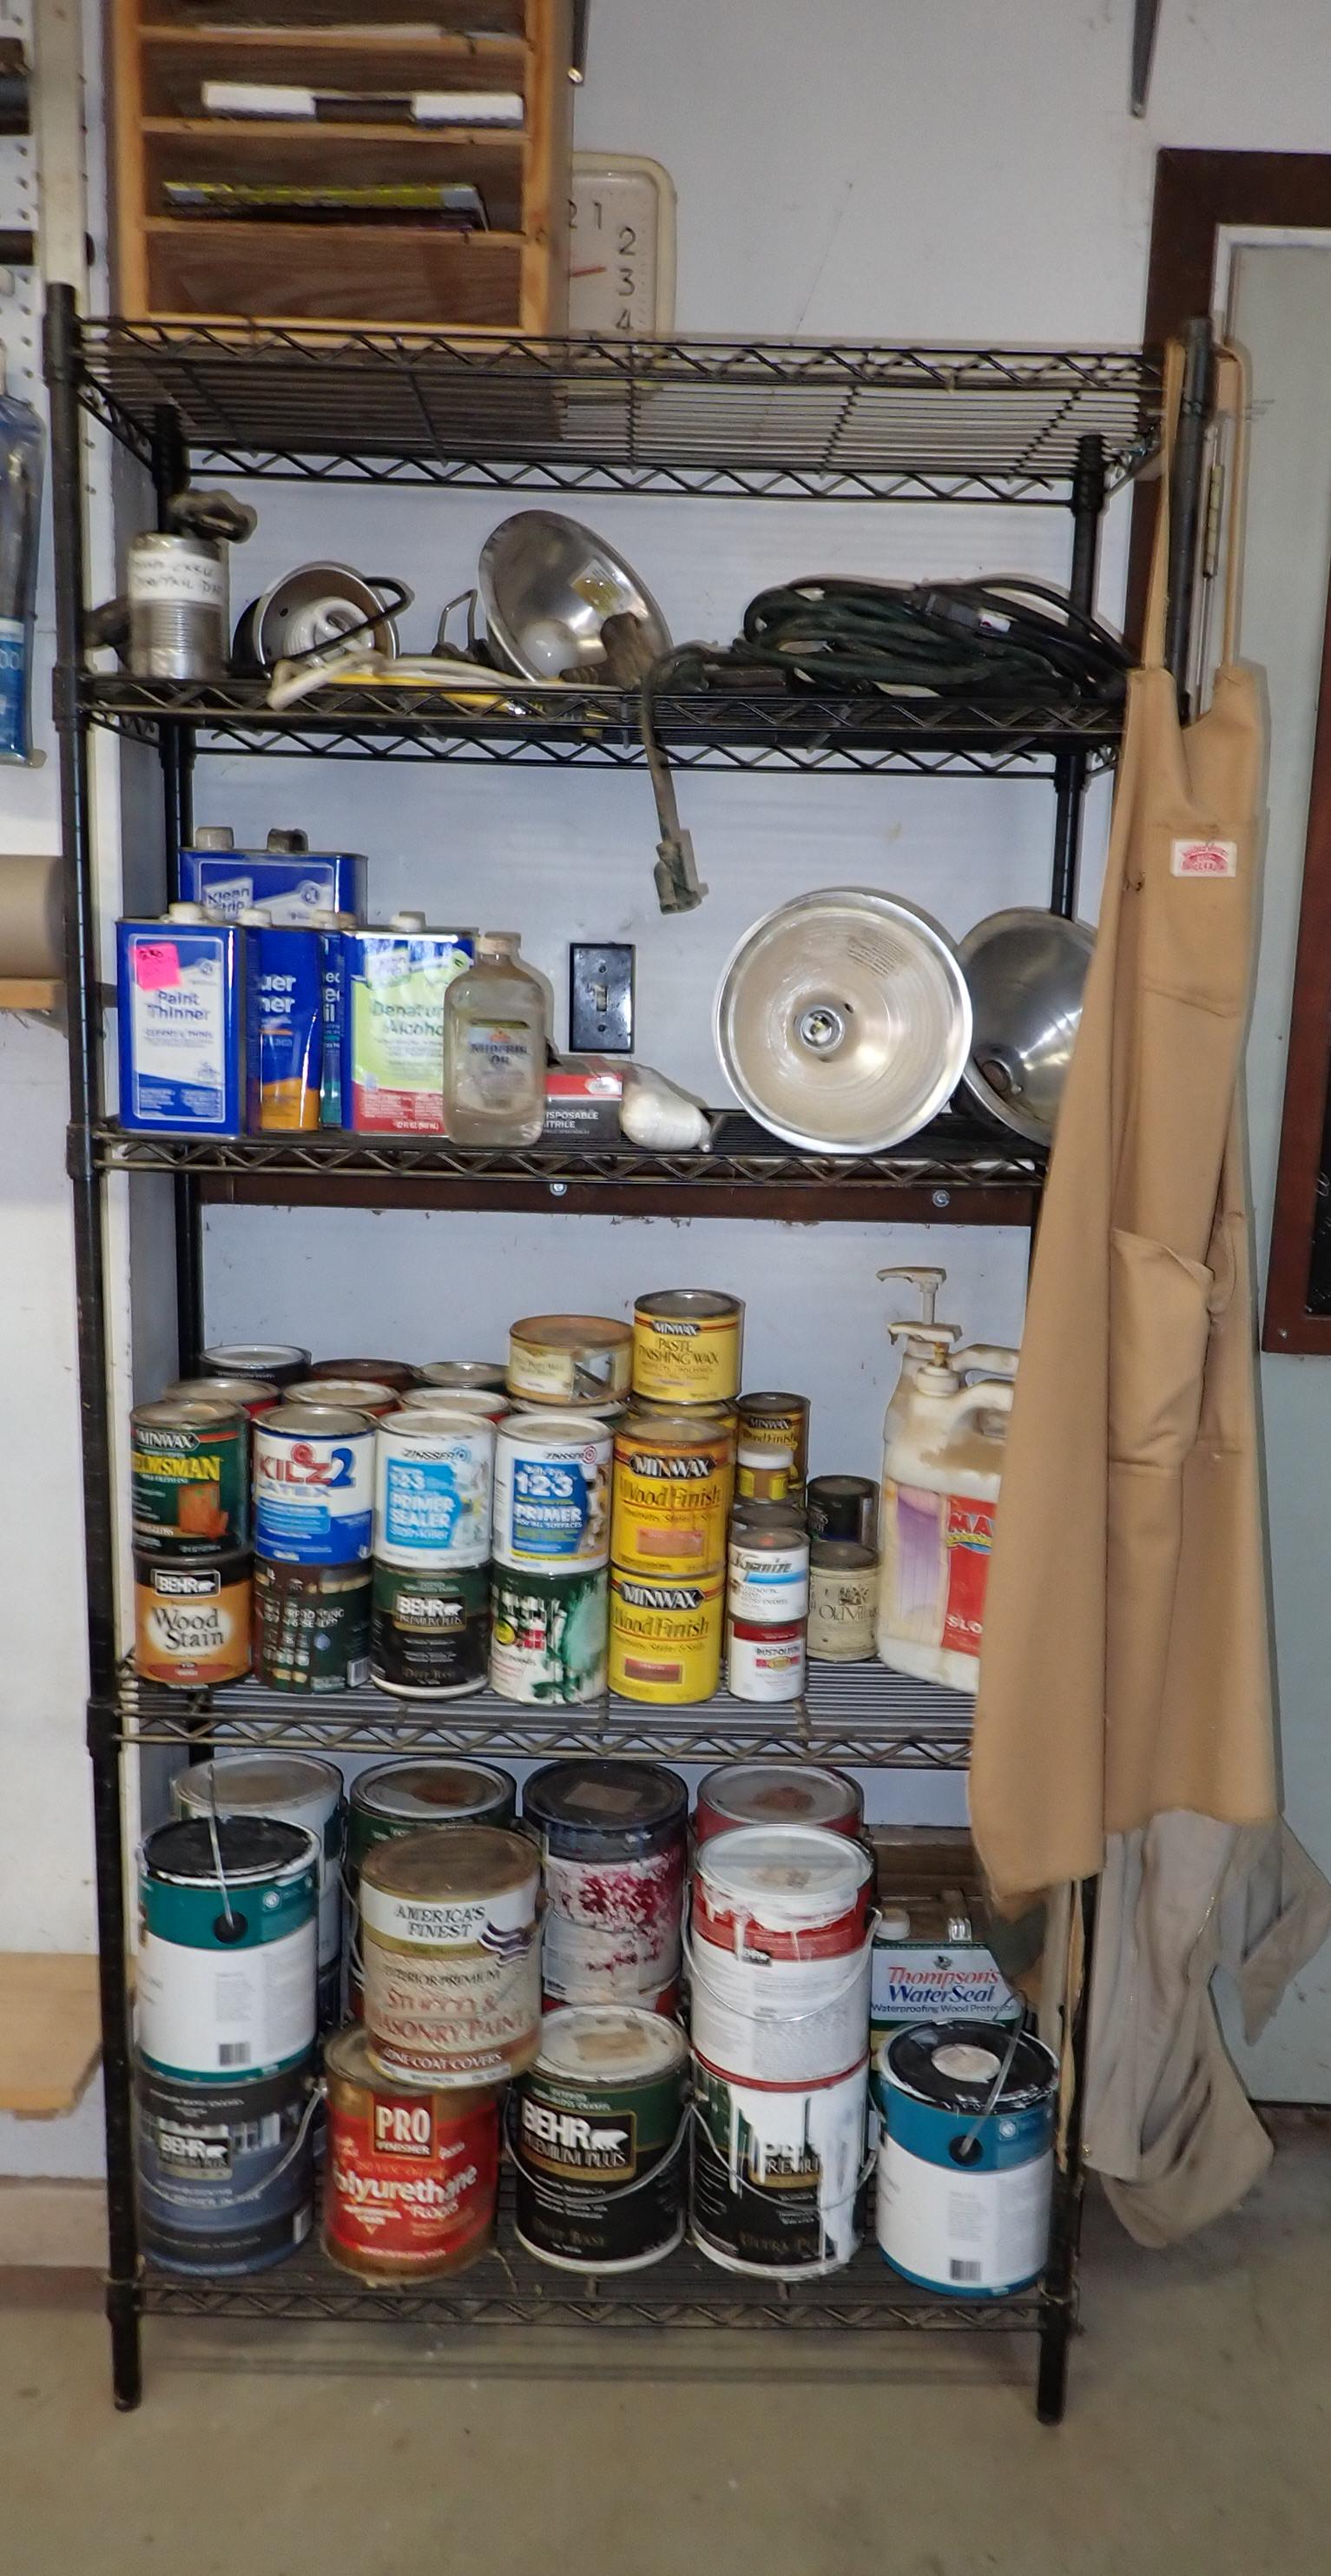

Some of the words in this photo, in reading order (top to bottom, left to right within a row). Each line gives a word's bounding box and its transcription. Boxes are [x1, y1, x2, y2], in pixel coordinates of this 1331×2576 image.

[593, 201, 603, 230] 1
[618, 226, 636, 256] 2
[616, 268, 636, 297] 3
[615, 308, 635, 330] 4
[157, 990, 201, 1007] Paint
[372, 999, 445, 1017] Denatur
[146, 1002, 211, 1021] Thinner
[385, 1019, 445, 1037] Alcoho
[544, 1111, 600, 1120] ISPOSABLE
[544, 1120, 577, 1129] ITRILE
[656, 1322, 698, 1336] MINWAX
[657, 1338, 694, 1353] PASTE
[694, 1351, 720, 1365] WAX
[750, 1418, 790, 1430] MINWAX
[402, 1448, 455, 1461] ZINSSER
[260, 1455, 333, 1485] KILZ
[329, 1446, 357, 1489] 2
[635, 1454, 711, 1478] MINWAX
[672, 1484, 722, 1509] Finish
[513, 1502, 583, 1522] PRIMER
[158, 1575, 199, 1593] BEHR
[623, 1582, 695, 1609] MINWAX
[396, 1594, 445, 1618] BEHR
[152, 1606, 219, 1630] Wood
[657, 1615, 710, 1637] Finish
[165, 1628, 224, 1650] Stain
[396, 1905, 485, 1924] AMERICA'S
[408, 1921, 472, 1939] FINEST
[888, 1966, 999, 1989] Thompson's
[888, 1985, 996, 2004] WaterSeal
[872, 2004, 939, 2014] Waterproofing
[940, 2004, 969, 2013] Wood
[412, 2056, 449, 2070] COAT
[450, 2051, 503, 2070] COVERS
[375, 2104, 432, 2143] PRO
[522, 2096, 591, 2150] BEHR
[159, 2132, 207, 2159] BEHR
